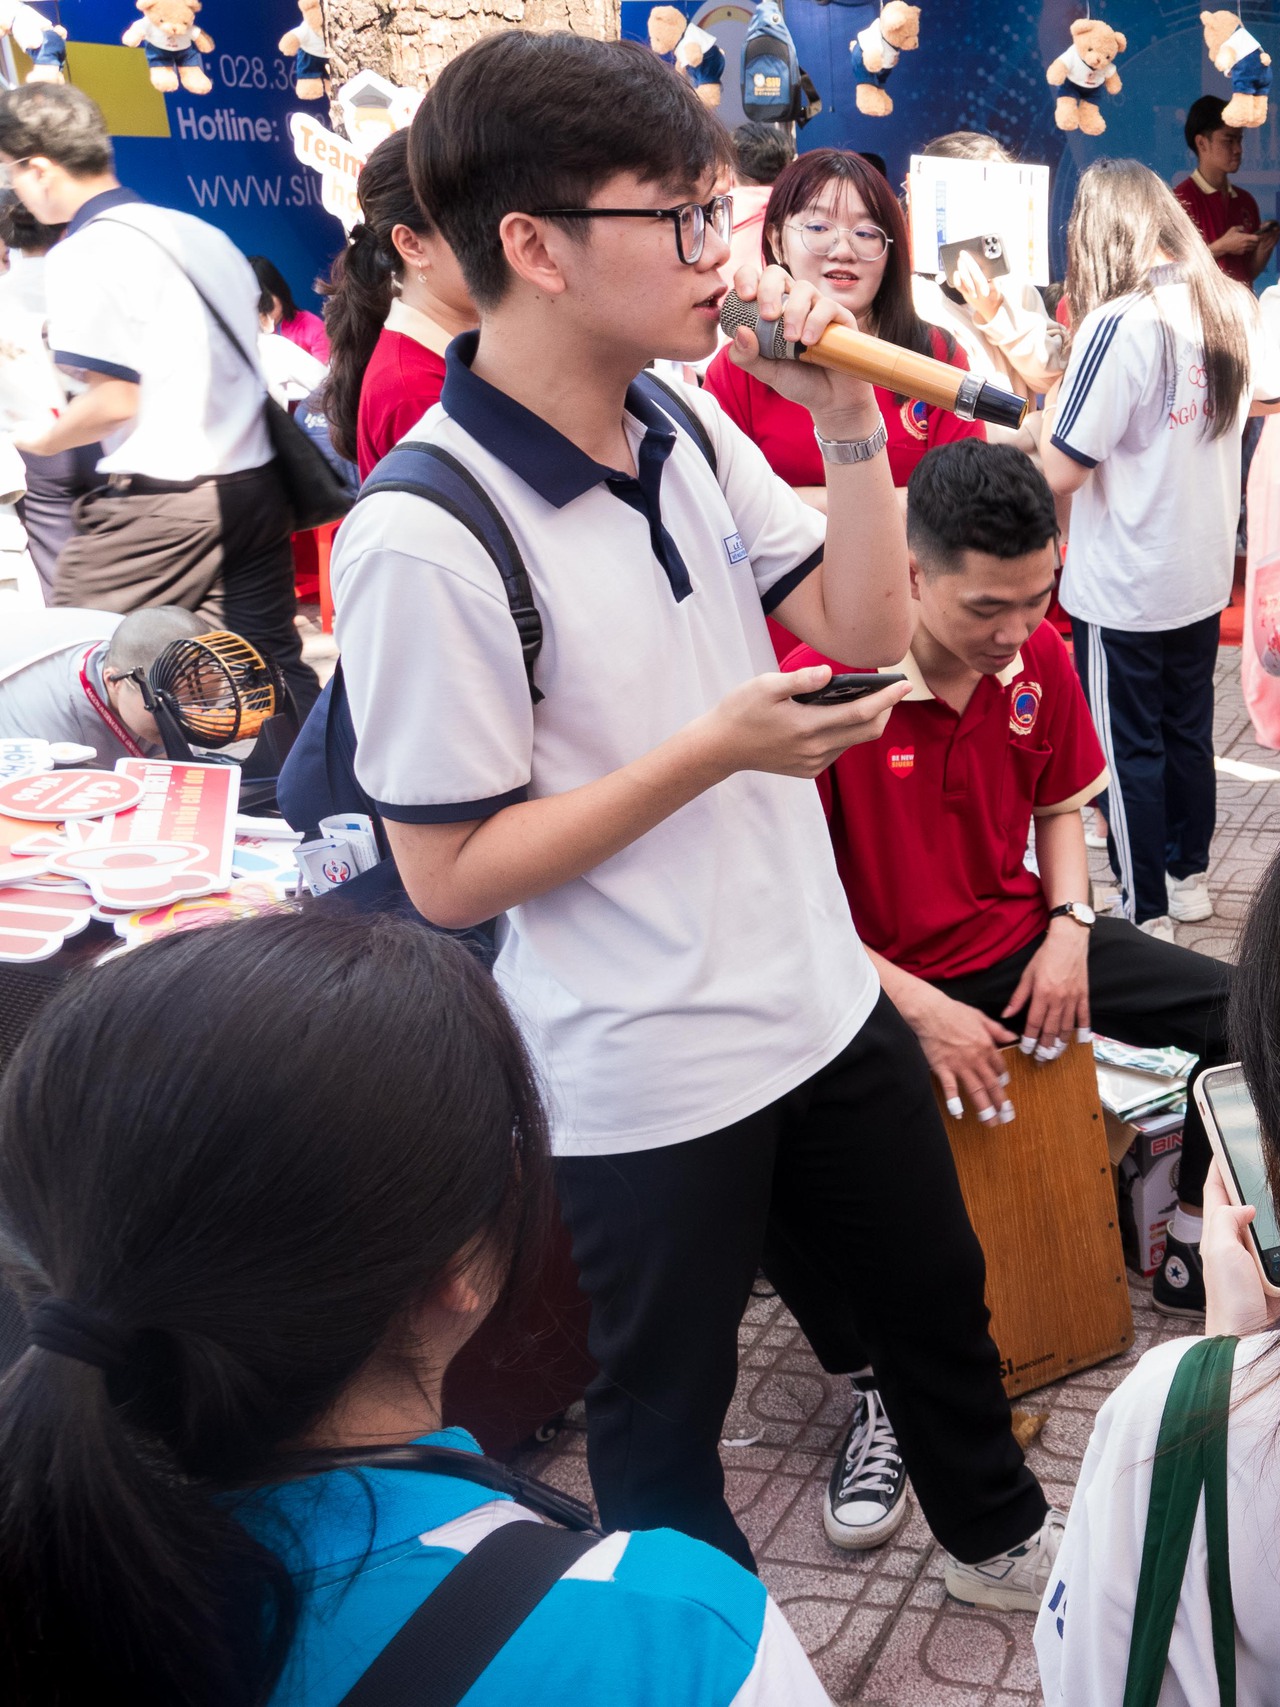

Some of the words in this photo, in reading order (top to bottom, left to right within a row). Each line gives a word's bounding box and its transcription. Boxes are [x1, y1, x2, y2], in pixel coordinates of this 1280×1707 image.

[177, 106, 280, 142] Hotline:
[85, 685, 102, 708] SAIGON
[98, 704, 128, 742] INTERNATIONAL
